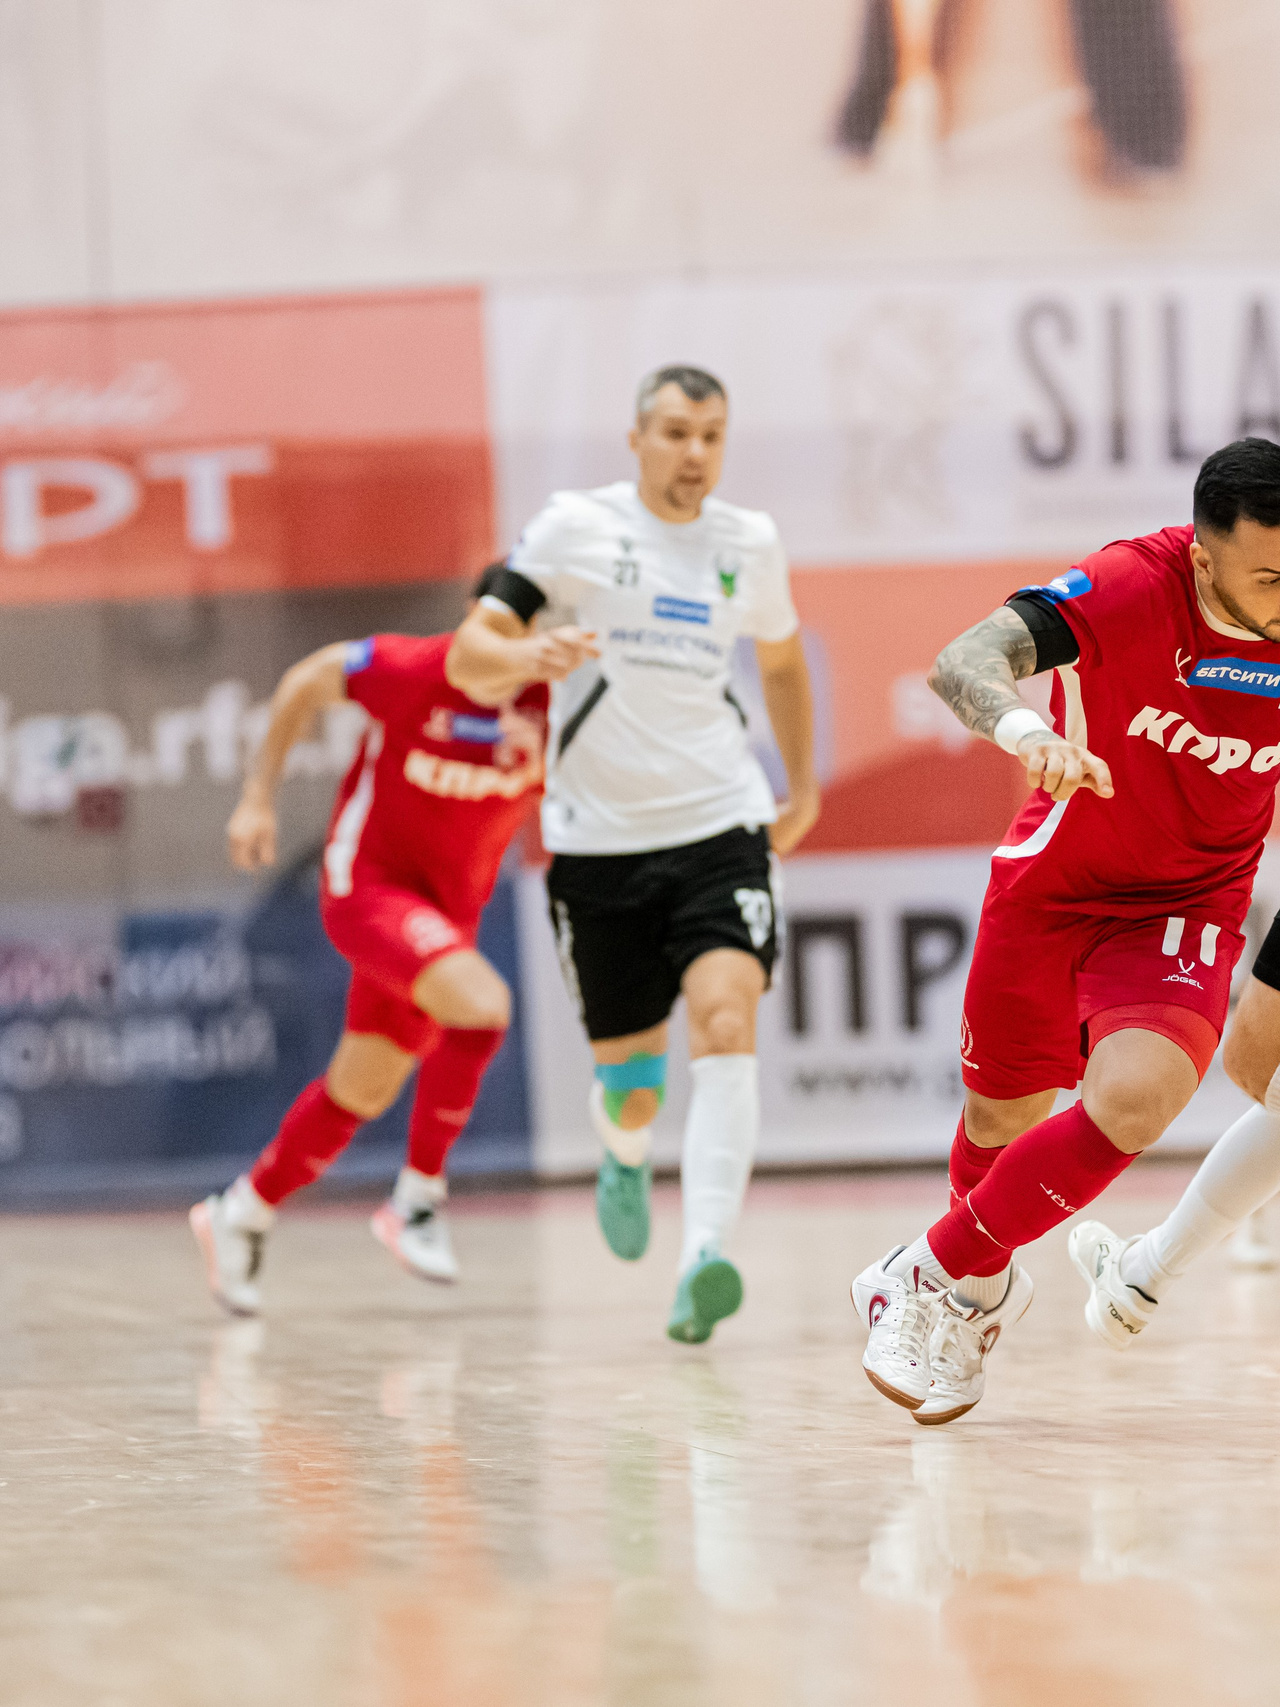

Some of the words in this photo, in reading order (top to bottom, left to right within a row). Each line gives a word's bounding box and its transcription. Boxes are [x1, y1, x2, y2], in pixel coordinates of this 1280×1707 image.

[2, 443, 272, 556] РТ
[1161, 916, 1222, 967] 11
[786, 912, 970, 1038] ПР
[1161, 973, 1205, 990] JÖGEL
[1039, 1182, 1078, 1213] JÖG
